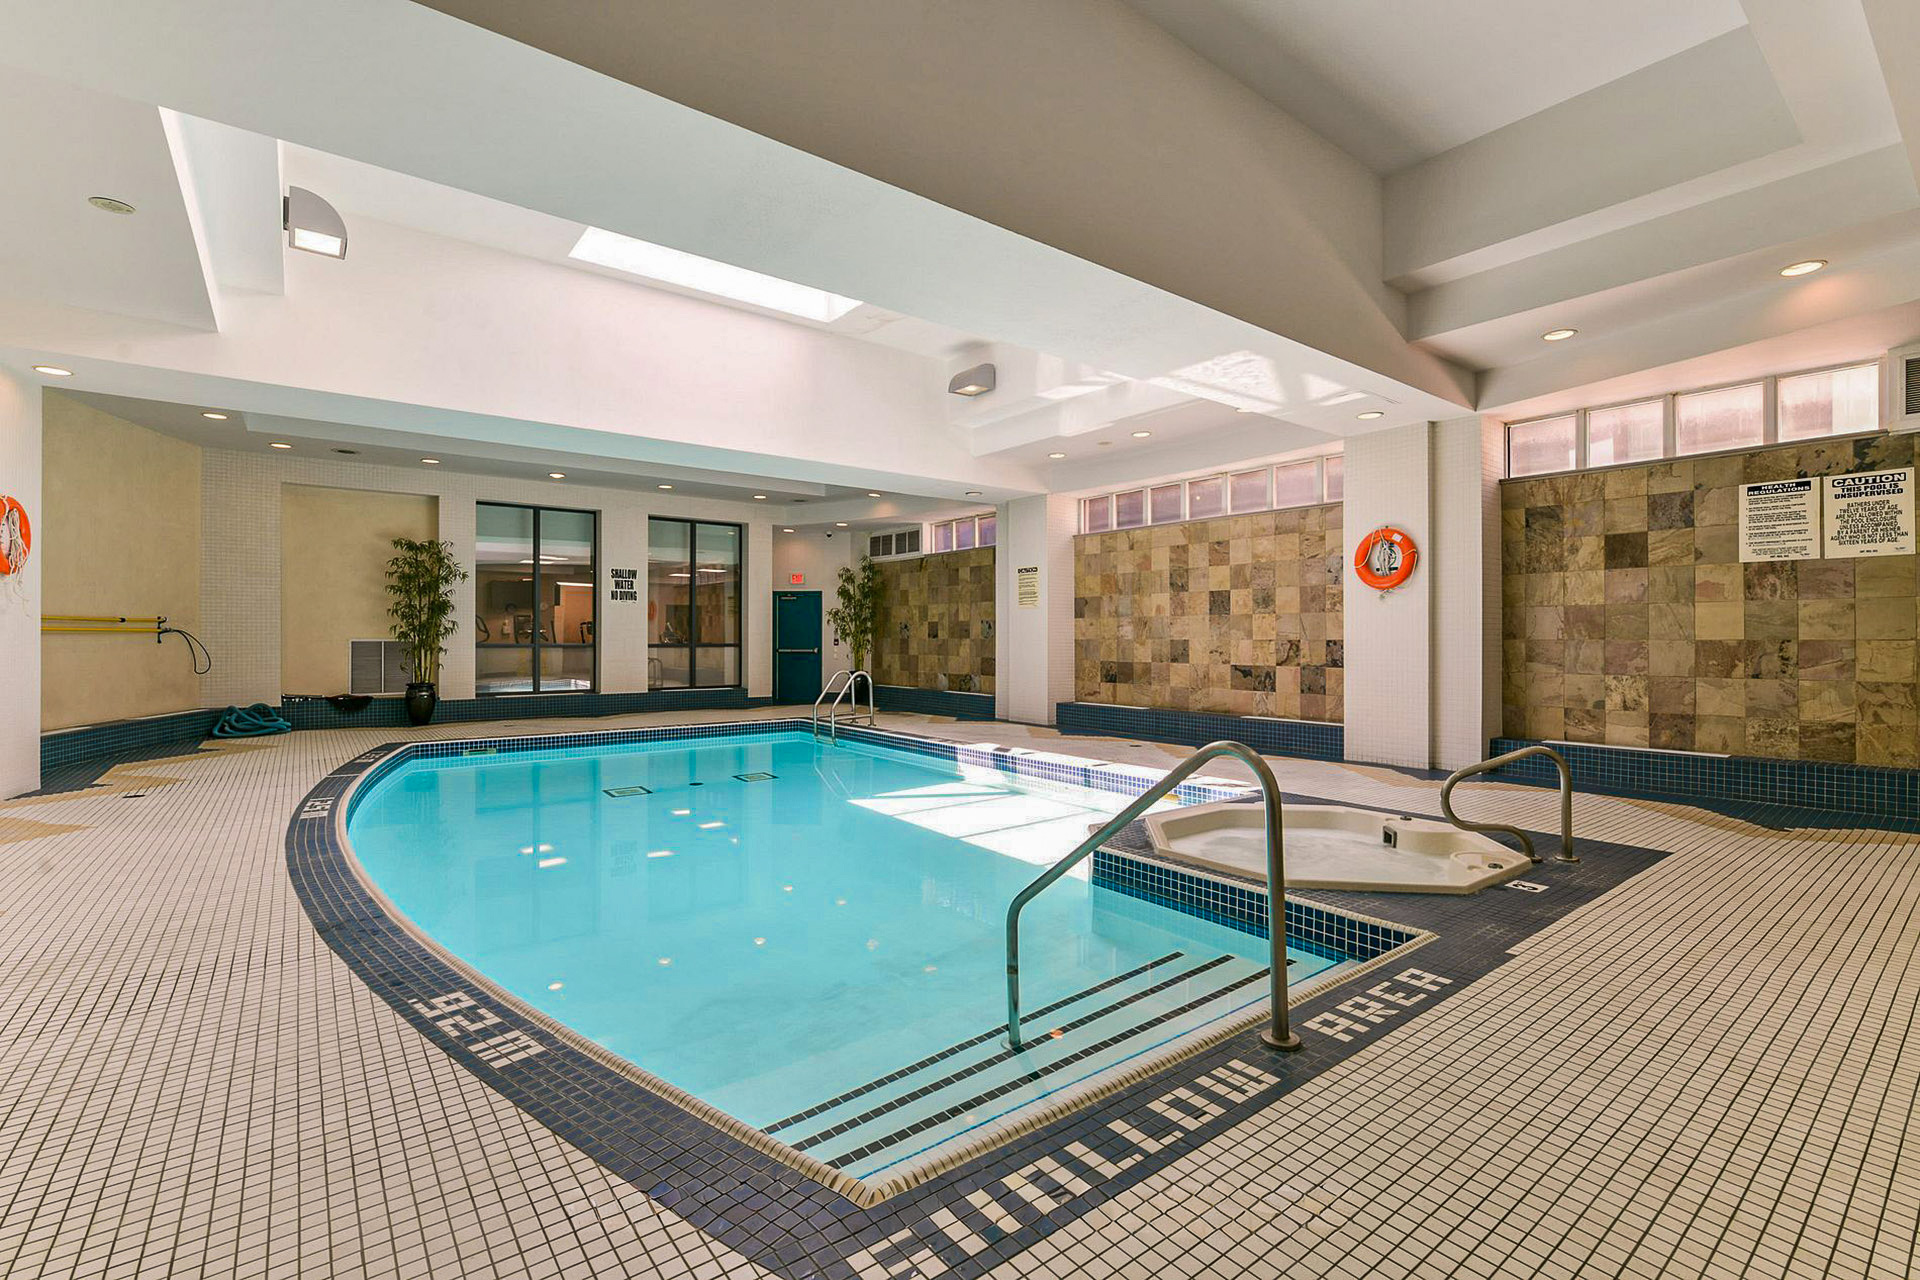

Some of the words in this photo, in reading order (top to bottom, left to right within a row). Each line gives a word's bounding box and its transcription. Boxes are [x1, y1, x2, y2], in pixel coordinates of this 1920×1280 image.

[1761, 482, 1796, 490] HEALTH
[1833, 473, 1905, 487] CAUTION
[1748, 486, 1810, 496] REGULATIONS
[1864, 483, 1887, 491] POOL
[1834, 488, 1904, 499] UNSUPERVISED
[610, 568, 638, 580] SHALLOW
[613, 579, 635, 590] WATER
[610, 590, 619, 601] NO
[619, 590, 638, 602] DIVING
[1302, 967, 1454, 1043] AREA
[467, 1029, 547, 1069] M
[845, 1059, 1282, 1280] SHALLOW
